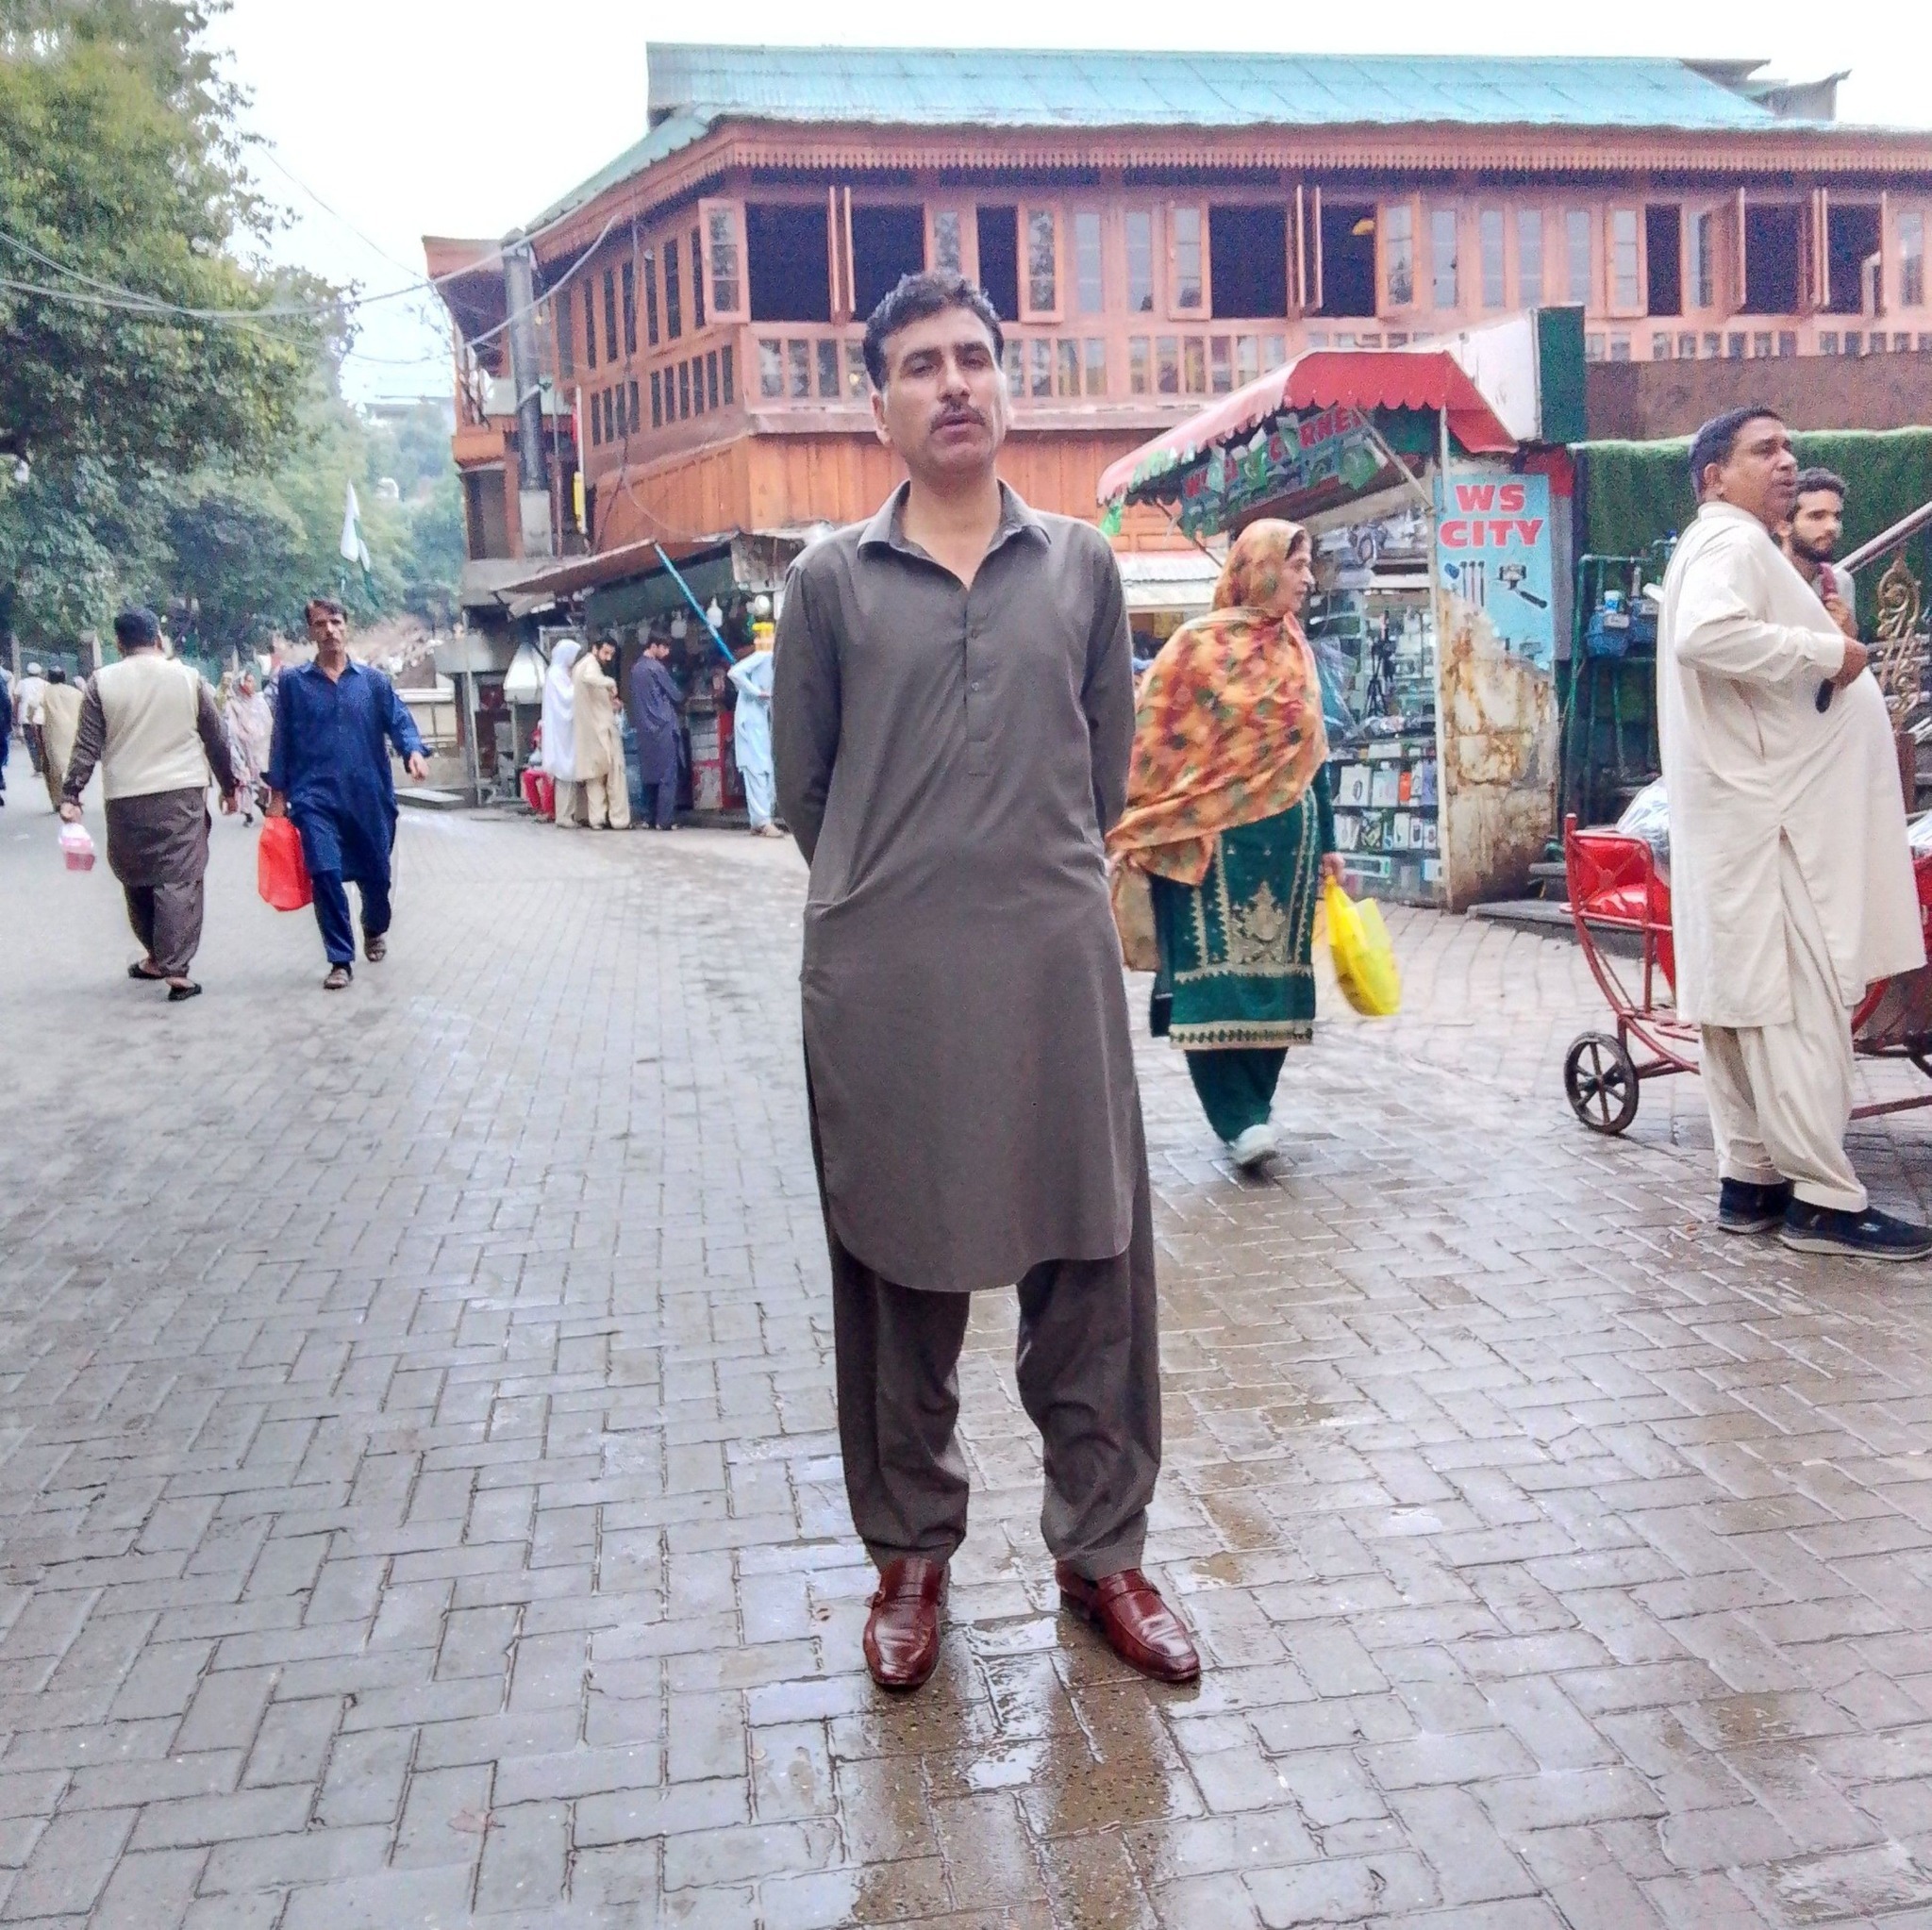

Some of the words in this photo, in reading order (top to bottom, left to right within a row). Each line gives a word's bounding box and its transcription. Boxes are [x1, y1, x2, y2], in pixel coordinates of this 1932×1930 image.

[1269, 406, 1363, 463] CRNE
[1456, 484, 1525, 512] WS
[1439, 519, 1544, 548] CITY
